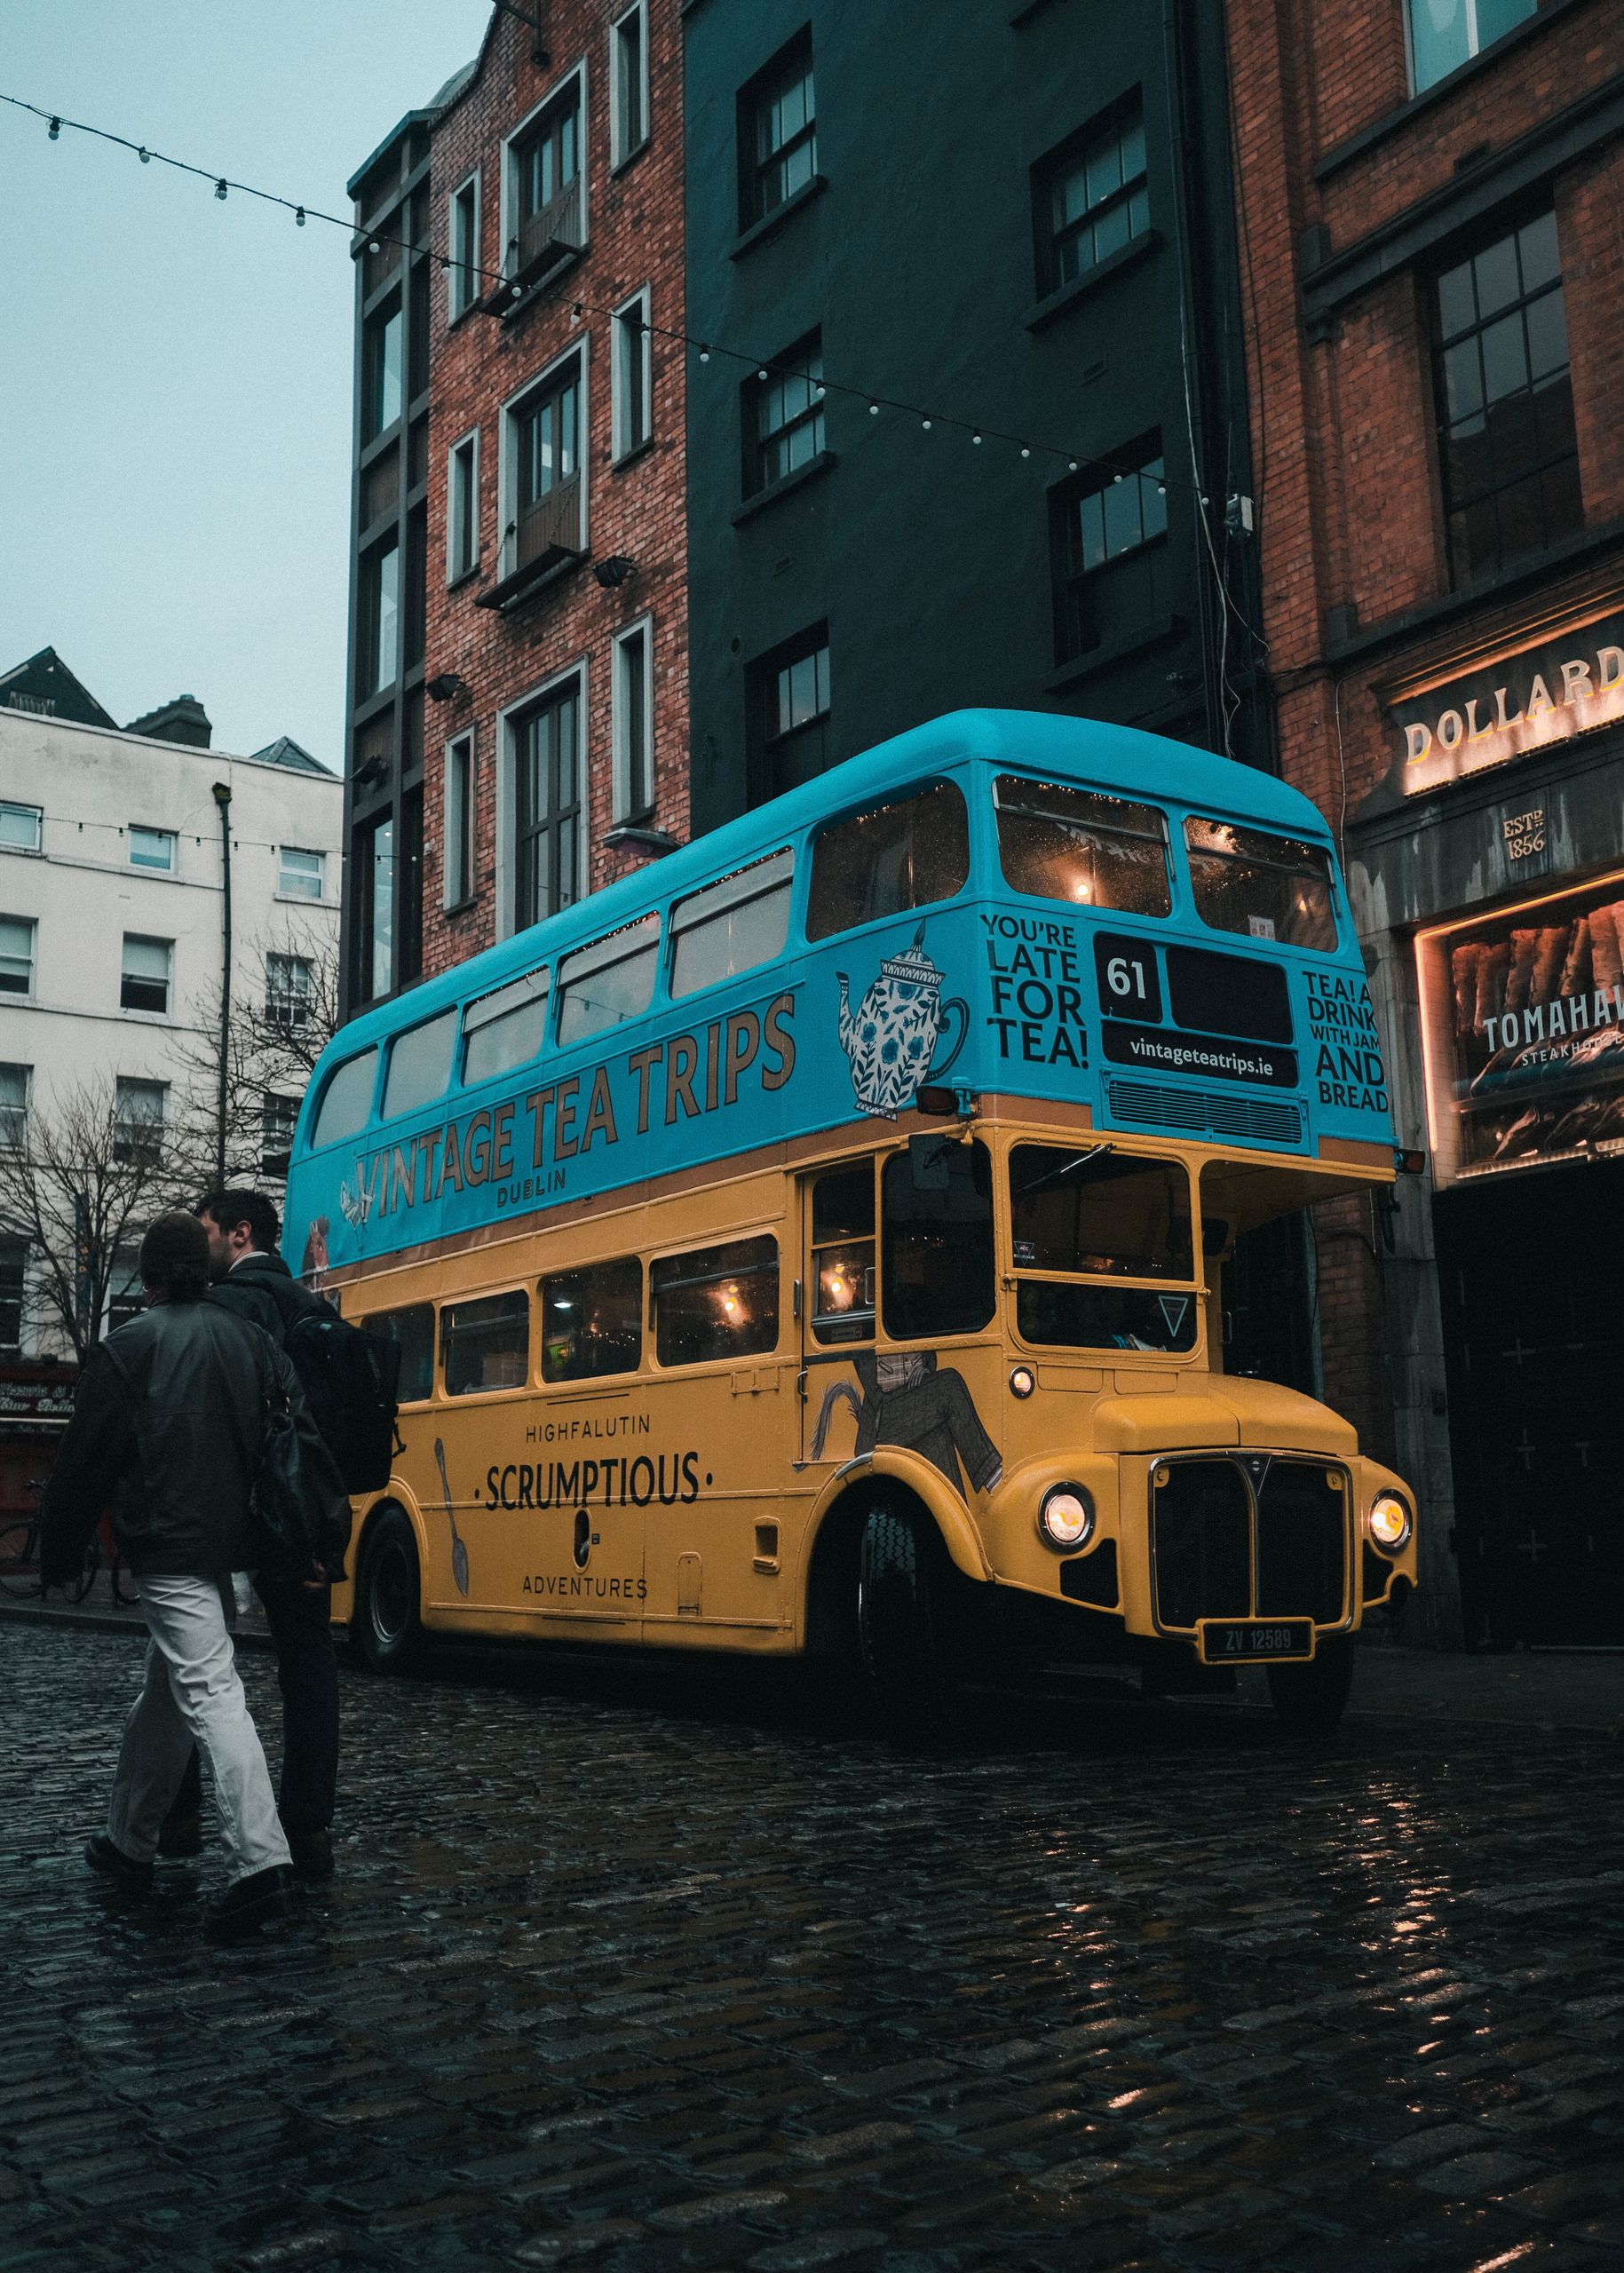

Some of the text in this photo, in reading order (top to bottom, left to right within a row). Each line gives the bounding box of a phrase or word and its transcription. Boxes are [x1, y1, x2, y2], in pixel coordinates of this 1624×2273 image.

[1404, 645, 1624, 765] DOLLARD
[1507, 830, 1545, 859] 1856
[980, 914, 1076, 948] YOU'RE
[986, 939, 1078, 985] LATE
[1106, 957, 1146, 1000] 61
[991, 975, 1082, 1028] FOR
[1302, 970, 1373, 1007] TEA! A
[1307, 996, 1378, 1033] DRINK
[1309, 1023, 1351, 1046] WITH
[986, 1018, 1089, 1070] TEA!
[1129, 1037, 1273, 1077] vintageteatrips.ie
[1315, 1044, 1385, 1086] AND
[356, 993, 796, 1223] VINTAGE TEA TRIPS
[1318, 1080, 1389, 1113] BREAD
[496, 1168, 566, 1208] DUBLIN
[526, 1414, 650, 1443] HIGHFALUTIN
[486, 1451, 699, 1511] SCRUMPTIOUS
[522, 1575, 647, 1599] ADVENTURES
[1225, 1628, 1291, 1651] ZV 12589
